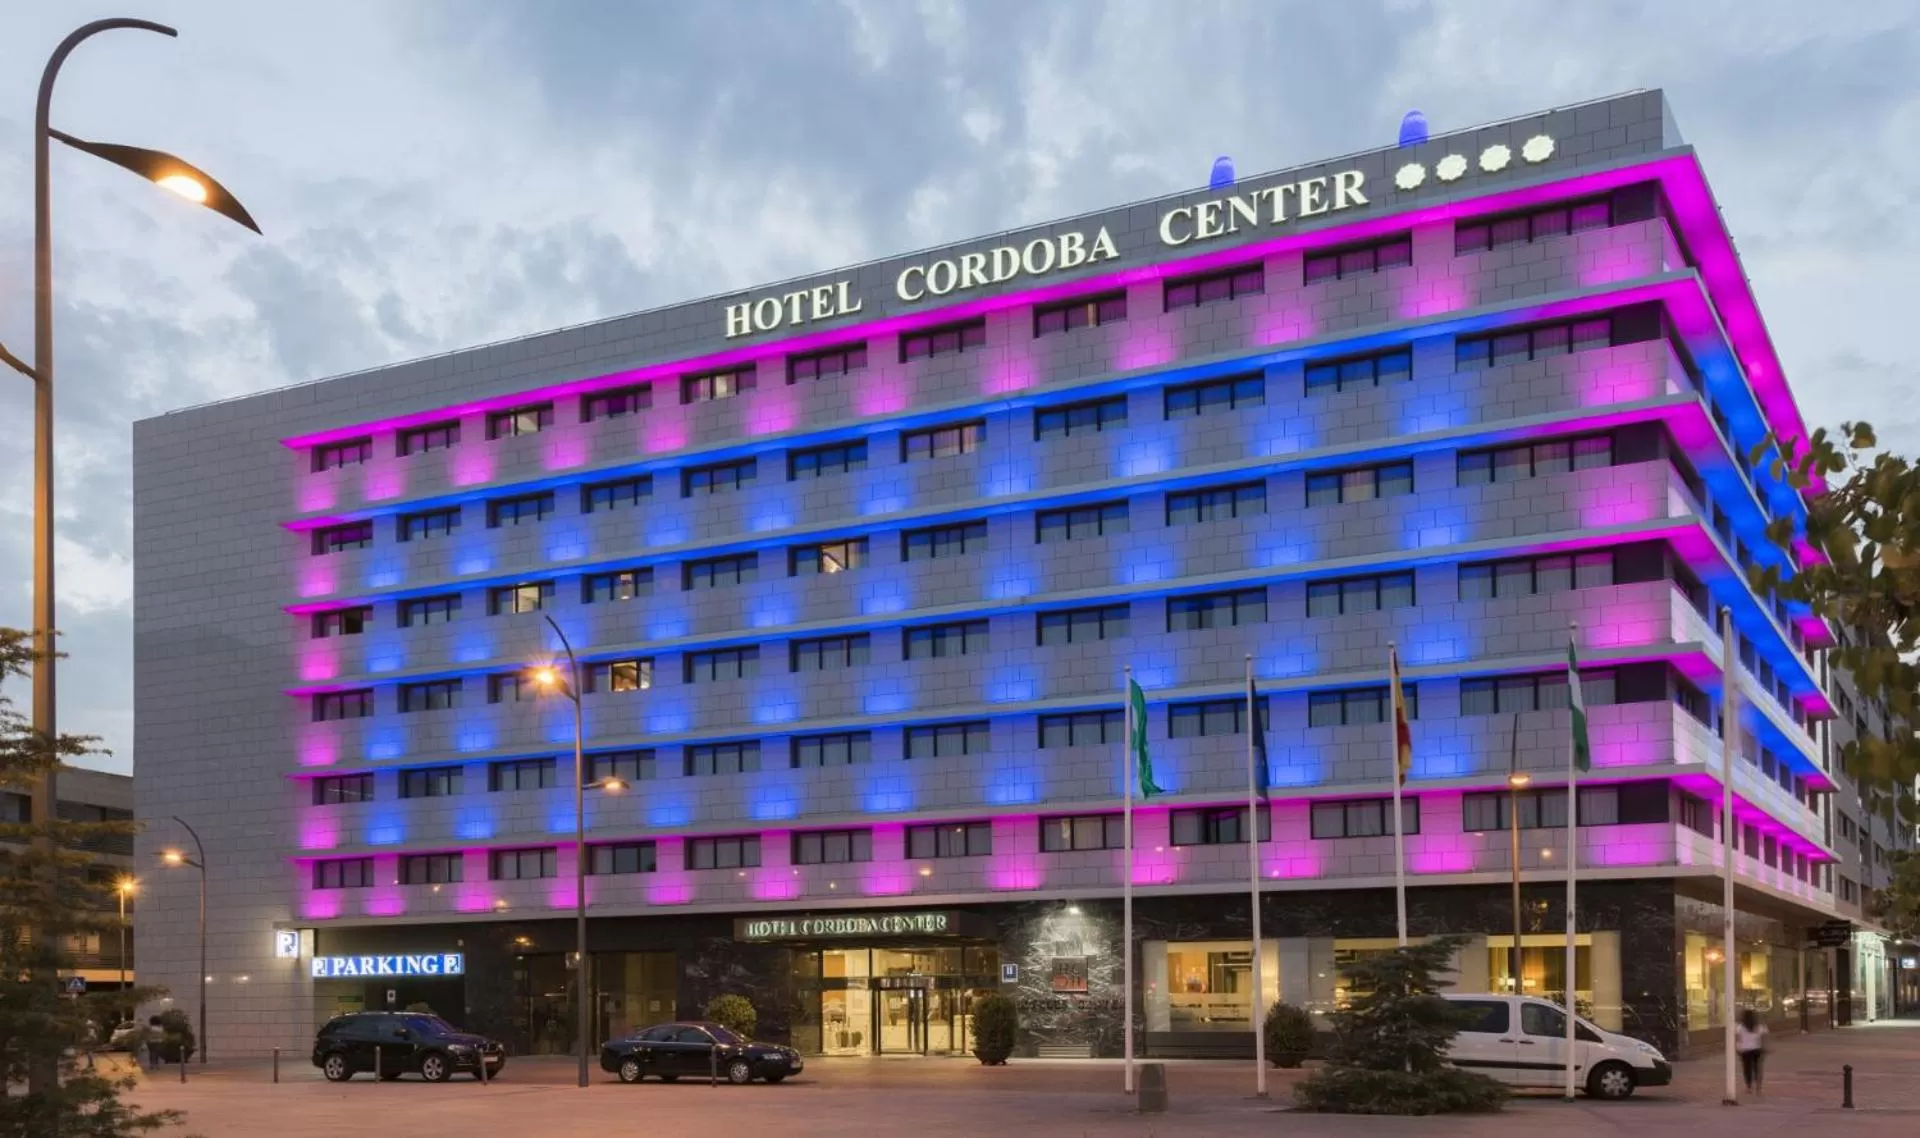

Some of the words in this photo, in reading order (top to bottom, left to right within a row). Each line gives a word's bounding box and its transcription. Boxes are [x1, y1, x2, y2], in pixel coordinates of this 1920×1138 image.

[724, 280, 862, 338] HOTEL
[896, 225, 1120, 301] CORDOBA
[1159, 170, 1370, 246] CENTER
[747, 920, 796, 937] HOTEL
[801, 917, 879, 935] CORDOBA
[880, 914, 947, 933] CENTER
[333, 955, 438, 975] PARKING
